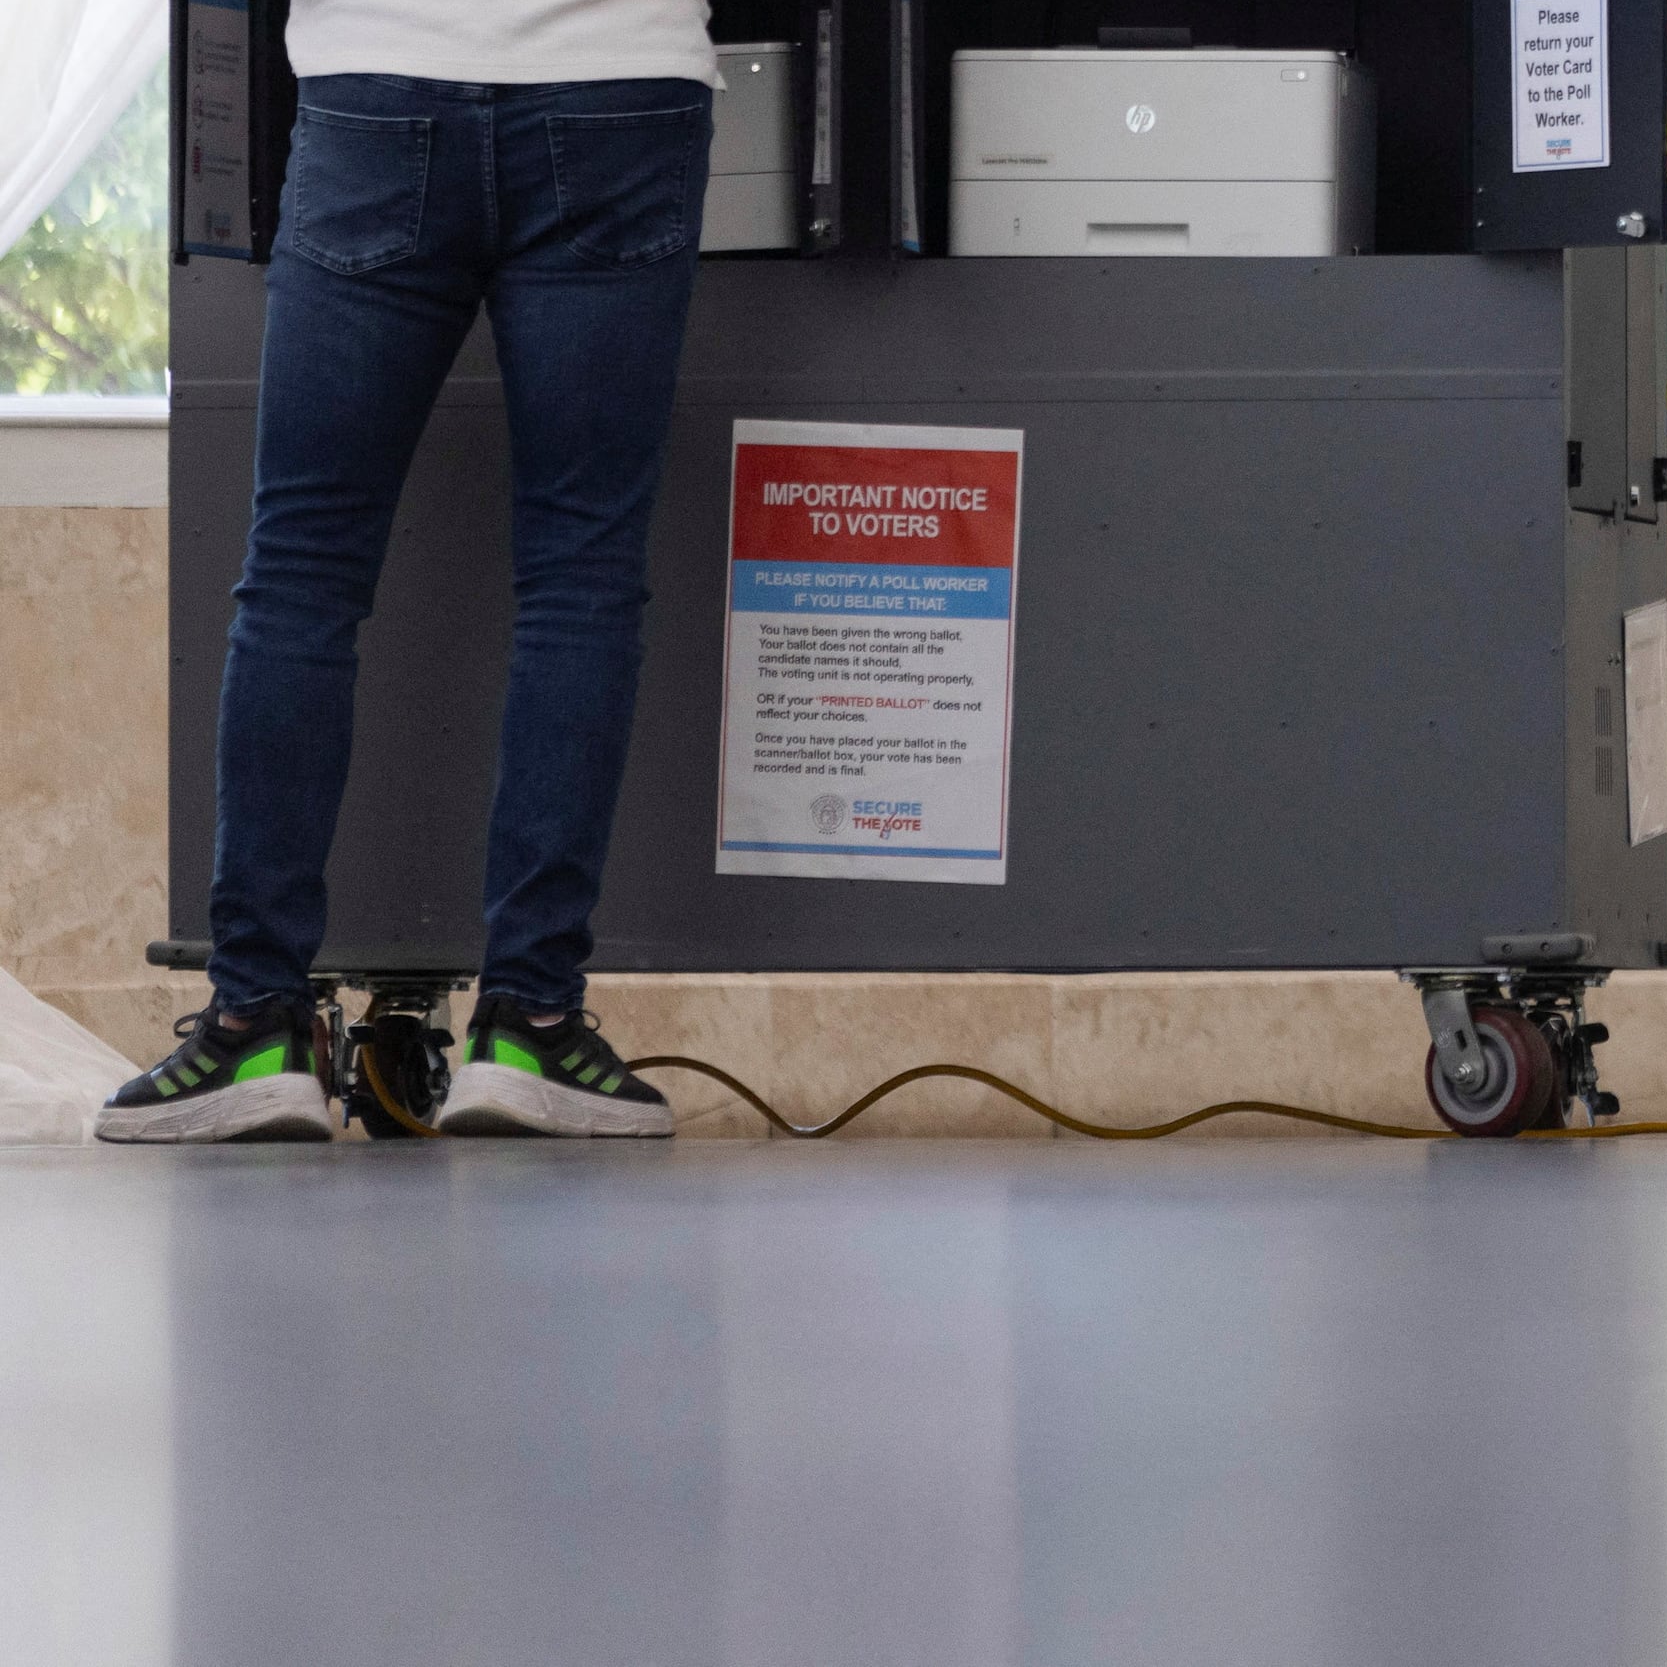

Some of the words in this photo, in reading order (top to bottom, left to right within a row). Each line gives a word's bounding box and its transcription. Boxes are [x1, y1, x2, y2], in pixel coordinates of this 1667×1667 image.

[1538, 9, 1579, 24] Please
[1524, 36, 1562, 51] return
[1566, 37, 1594, 52] your
[1526, 61, 1559, 76] Voter
[1563, 59, 1592, 74] Card
[1528, 89, 1540, 102] to
[1544, 87, 1563, 101] the
[1567, 85, 1590, 100] Poll
[1129, 106, 1153, 132] hp
[1536, 110, 1584, 128] Worker.
[763, 483, 893, 508] IMPORTANT
[902, 487, 987, 511] NOTICE
[809, 513, 840, 535] TO
[847, 514, 940, 538] VOTERS
[755, 572, 811, 586] PLEASE
[815, 574, 865, 588] NOTIFY
[870, 575, 879, 588] A
[882, 576, 918, 589] POLL
[923, 577, 988, 591] WORKER
[795, 594, 805, 606] IF
[812, 594, 840, 607] YOU
[844, 595, 904, 610] BELIEVE
[910, 598, 946, 611] THAT:
[760, 625, 780, 635] You
[783, 625, 808, 636] have
[812, 626, 838, 637] been
[841, 627, 870, 641] given
[873, 628, 890, 638] the
[894, 631, 927, 642] wrong
[759, 639, 783, 650] Your
[787, 640, 816, 651] ballot
[820, 641, 845, 652] does
[849, 641, 866, 652] not
[870, 642, 908, 653] contain
[912, 643, 924, 653] all
[927, 643, 943, 654] the
[758, 653, 811, 665] candidate
[814, 657, 849, 666] names
[853, 656, 859, 666] it
[758, 668, 778, 678] The
[782, 668, 815, 682] voting
[818, 670, 838, 680] unit
[841, 670, 850, 681] is
[853, 671, 870, 681] not
[874, 671, 924, 686] operating
[757, 694, 775, 704] OR
[778, 694, 785, 705] if
[788, 697, 813, 708] your
[933, 699, 960, 710] does
[964, 700, 982, 711] not
[852, 800, 922, 816] SECURE
